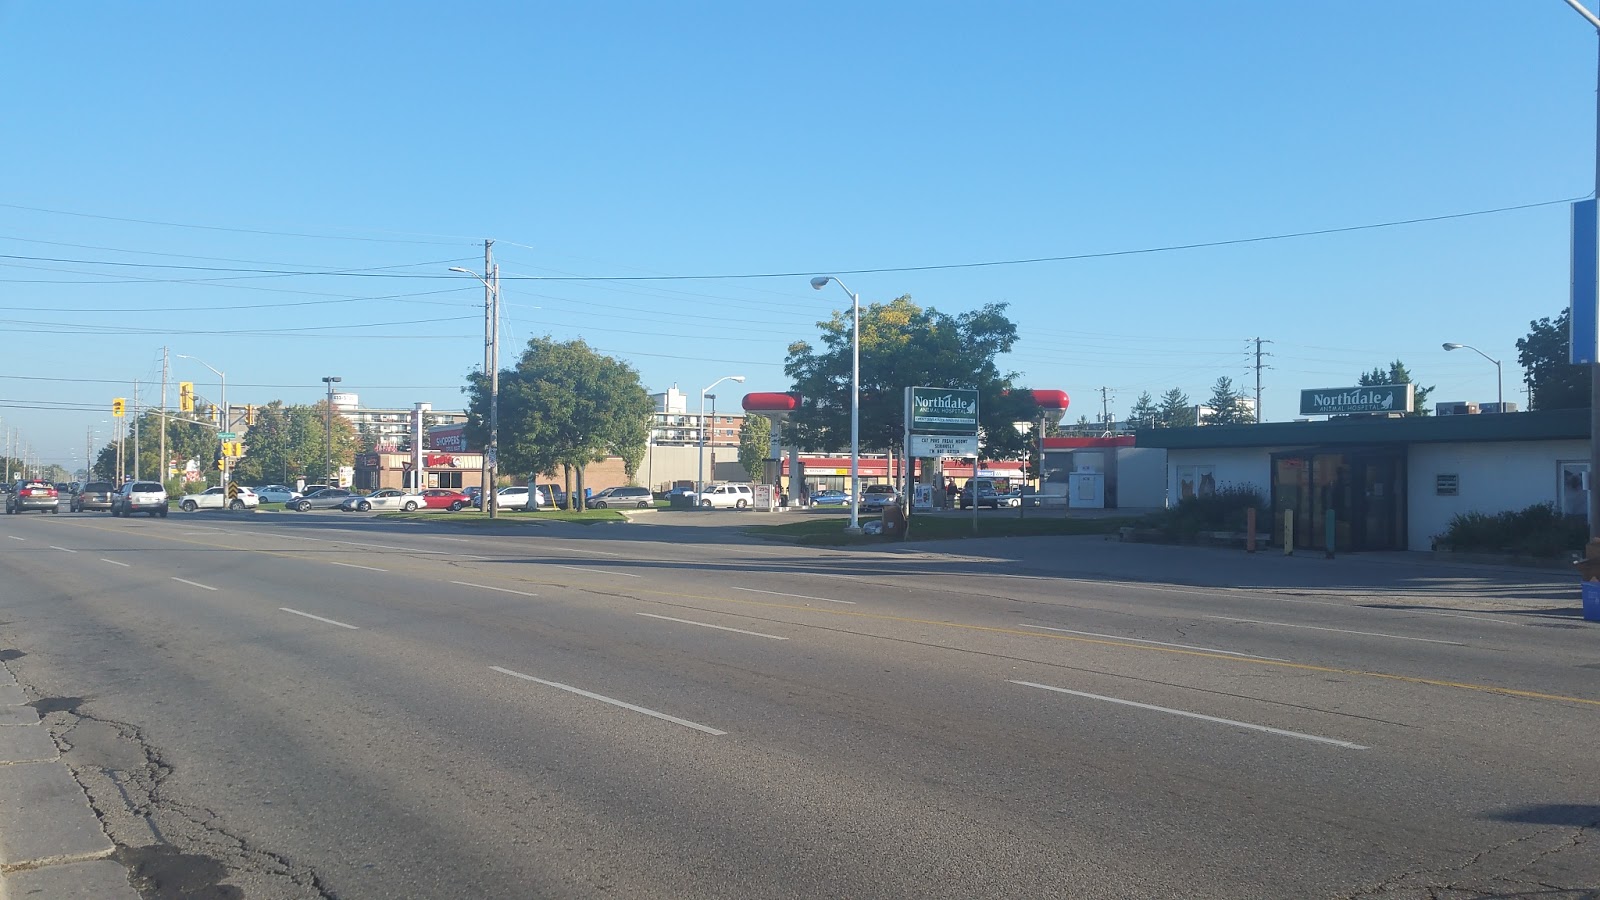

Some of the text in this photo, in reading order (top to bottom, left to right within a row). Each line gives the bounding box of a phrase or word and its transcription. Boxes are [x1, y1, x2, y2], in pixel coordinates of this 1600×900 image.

[915, 395, 967, 408] Northdale
[1314, 390, 1381, 406] Northdale
[436, 435, 460, 446] SHOPPERS
